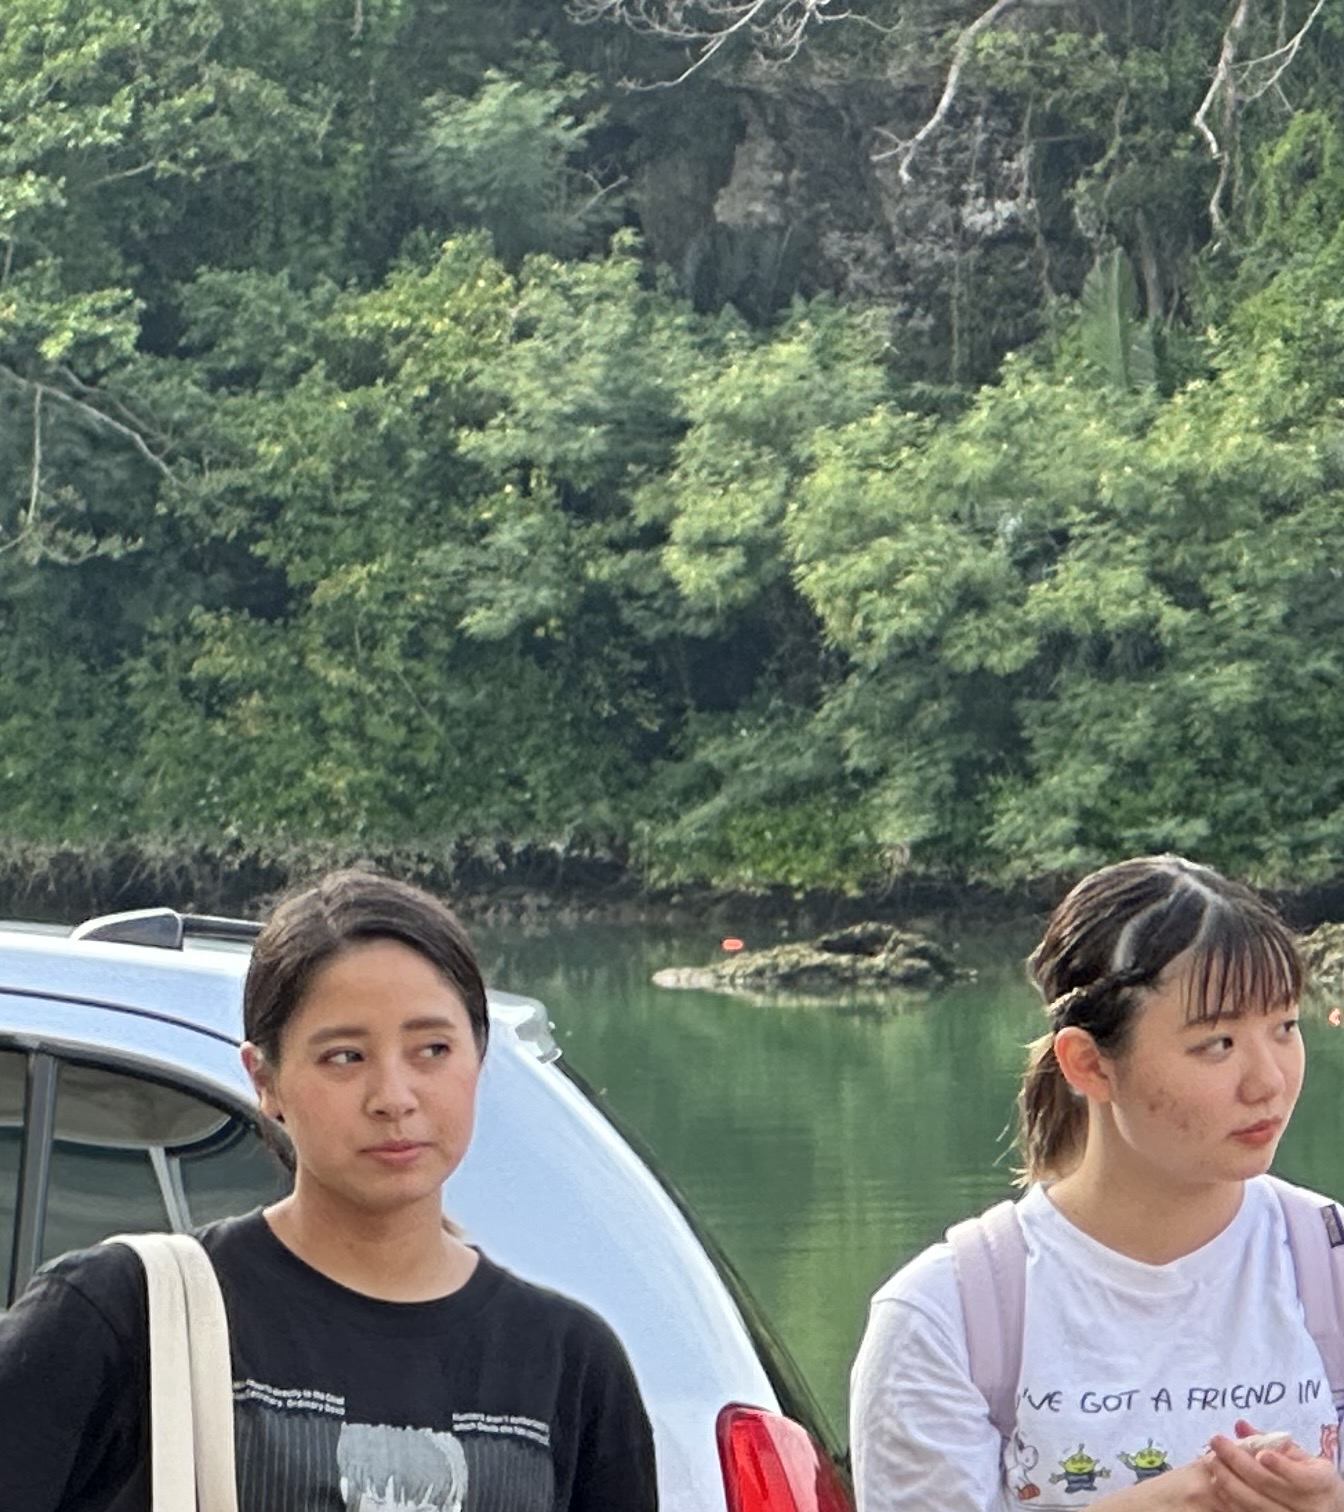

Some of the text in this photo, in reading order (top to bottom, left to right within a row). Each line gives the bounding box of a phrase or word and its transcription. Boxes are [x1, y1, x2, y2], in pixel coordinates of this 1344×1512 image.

[1080, 1389, 1140, 1413] GOT
[1150, 1388, 1172, 1411] A
[1187, 1381, 1286, 1410] FRIEND
[1298, 1380, 1322, 1404] IN
